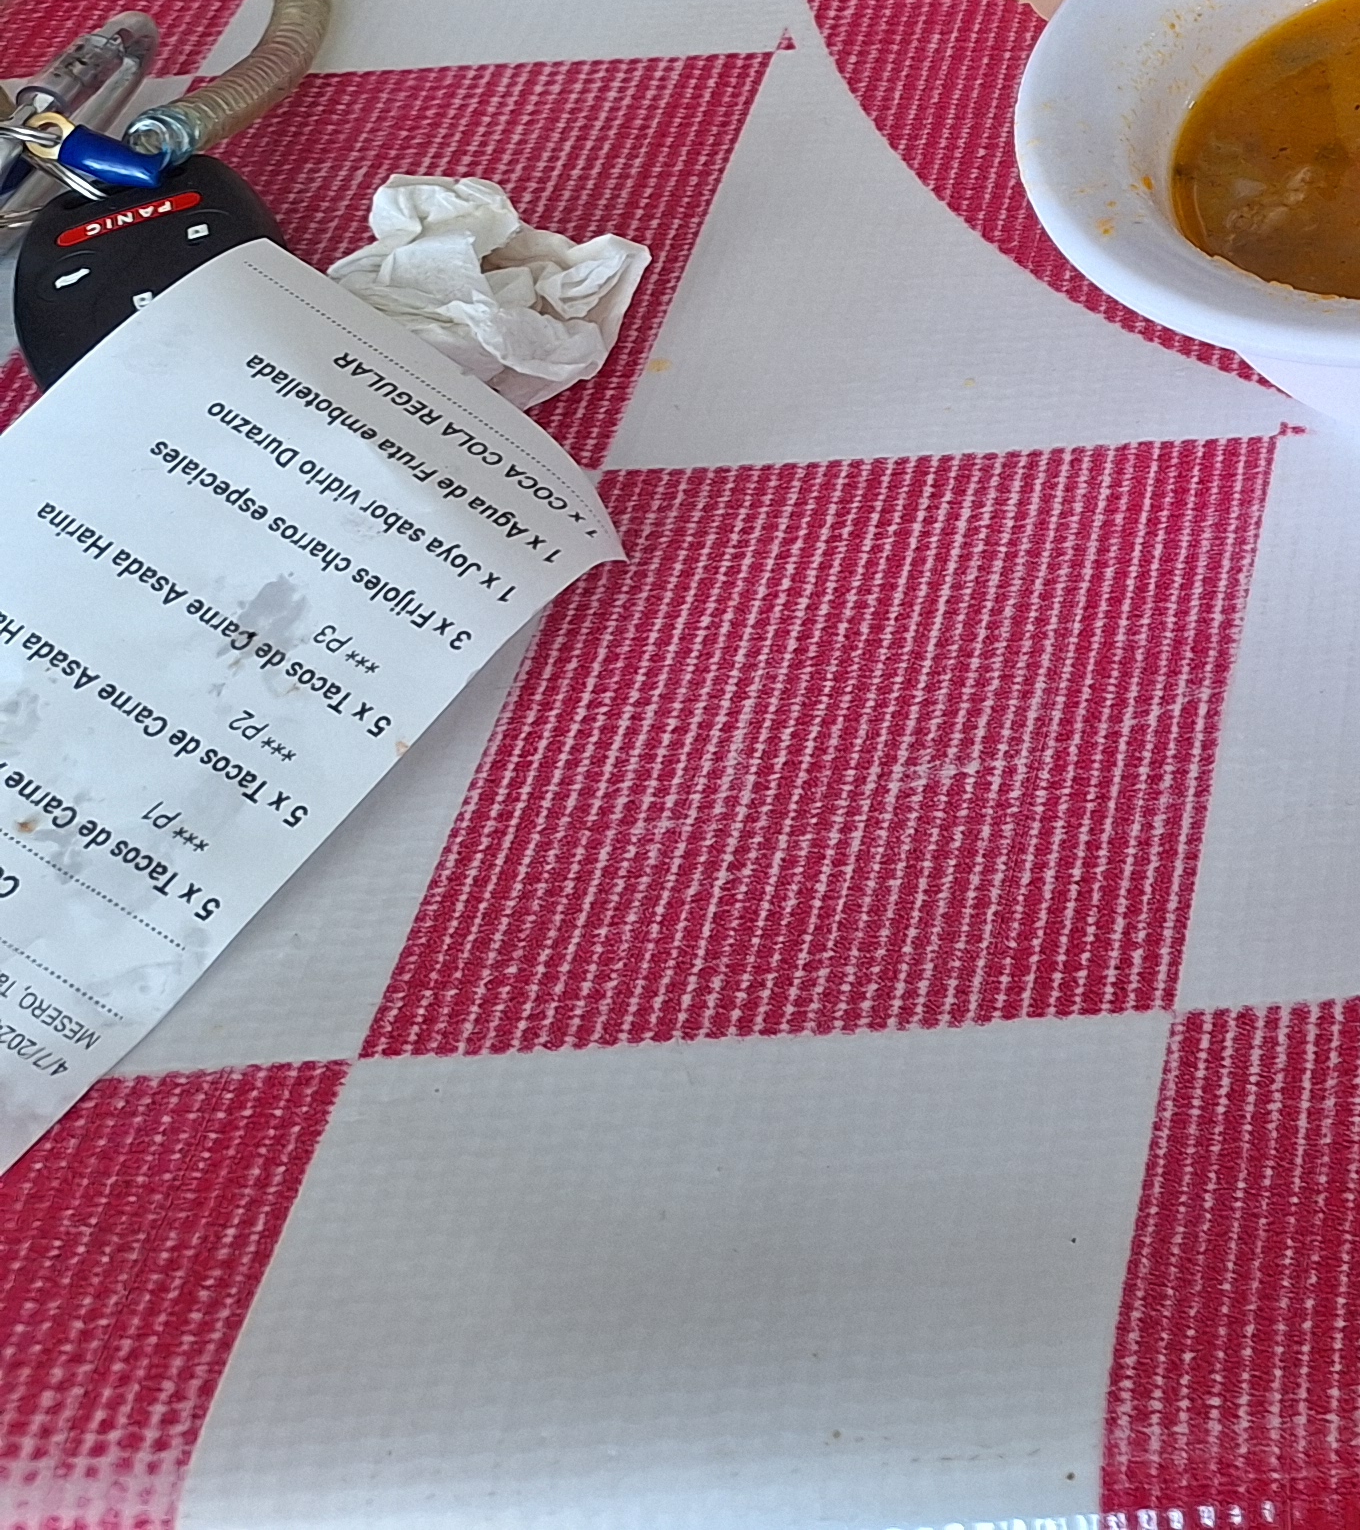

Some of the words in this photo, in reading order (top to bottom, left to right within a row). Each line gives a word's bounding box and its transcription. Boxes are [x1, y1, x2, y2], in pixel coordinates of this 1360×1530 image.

[85, 201, 173, 237] PANIC
[246, 354, 377, 442] embotellada
[334, 352, 444, 427] REGULAR
[206, 401, 300, 469] Durazno
[441, 421, 503, 466] COLA
[150, 440, 269, 521] especiales
[299, 459, 362, 506] vidrio
[378, 437, 439, 484] Fruta
[437, 477, 469, 501] de
[504, 463, 568, 512] COCA
[37, 502, 115, 558] Harina
[360, 499, 427, 544] sabor
[468, 495, 529, 540] Agua
[569, 510, 587, 524] x
[268, 516, 352, 573] charros
[425, 535, 482, 579] Joya
[526, 535, 547, 551] x
[543, 548, 562, 564] 1
[112, 548, 189, 605] Asada
[352, 567, 437, 629] Frijoles
[479, 572, 501, 589] x
[497, 585, 517, 603] 1
[186, 598, 258, 652] Carne
[432, 617, 455, 635] x
[449, 629, 472, 651] 3
[22, 633, 102, 690] Asada
[254, 641, 287, 670] de
[97, 682, 169, 738] Carne
[285, 660, 352, 715] Tacos
[352, 701, 374, 722] x
[366, 714, 392, 738] 5
[168, 729, 201, 758] de
[200, 747, 269, 805] Tacos
[4, 770, 78, 829] Carne
[267, 791, 292, 812] x
[282, 805, 309, 828] 5
[78, 818, 112, 850] de
[110, 839, 180, 897] Tacos
[178, 882, 203, 904] x
[193, 897, 222, 922] 5
[18, 985, 101, 1050] MESERO,
[0, 1019, 69, 1076] 4/7/202
